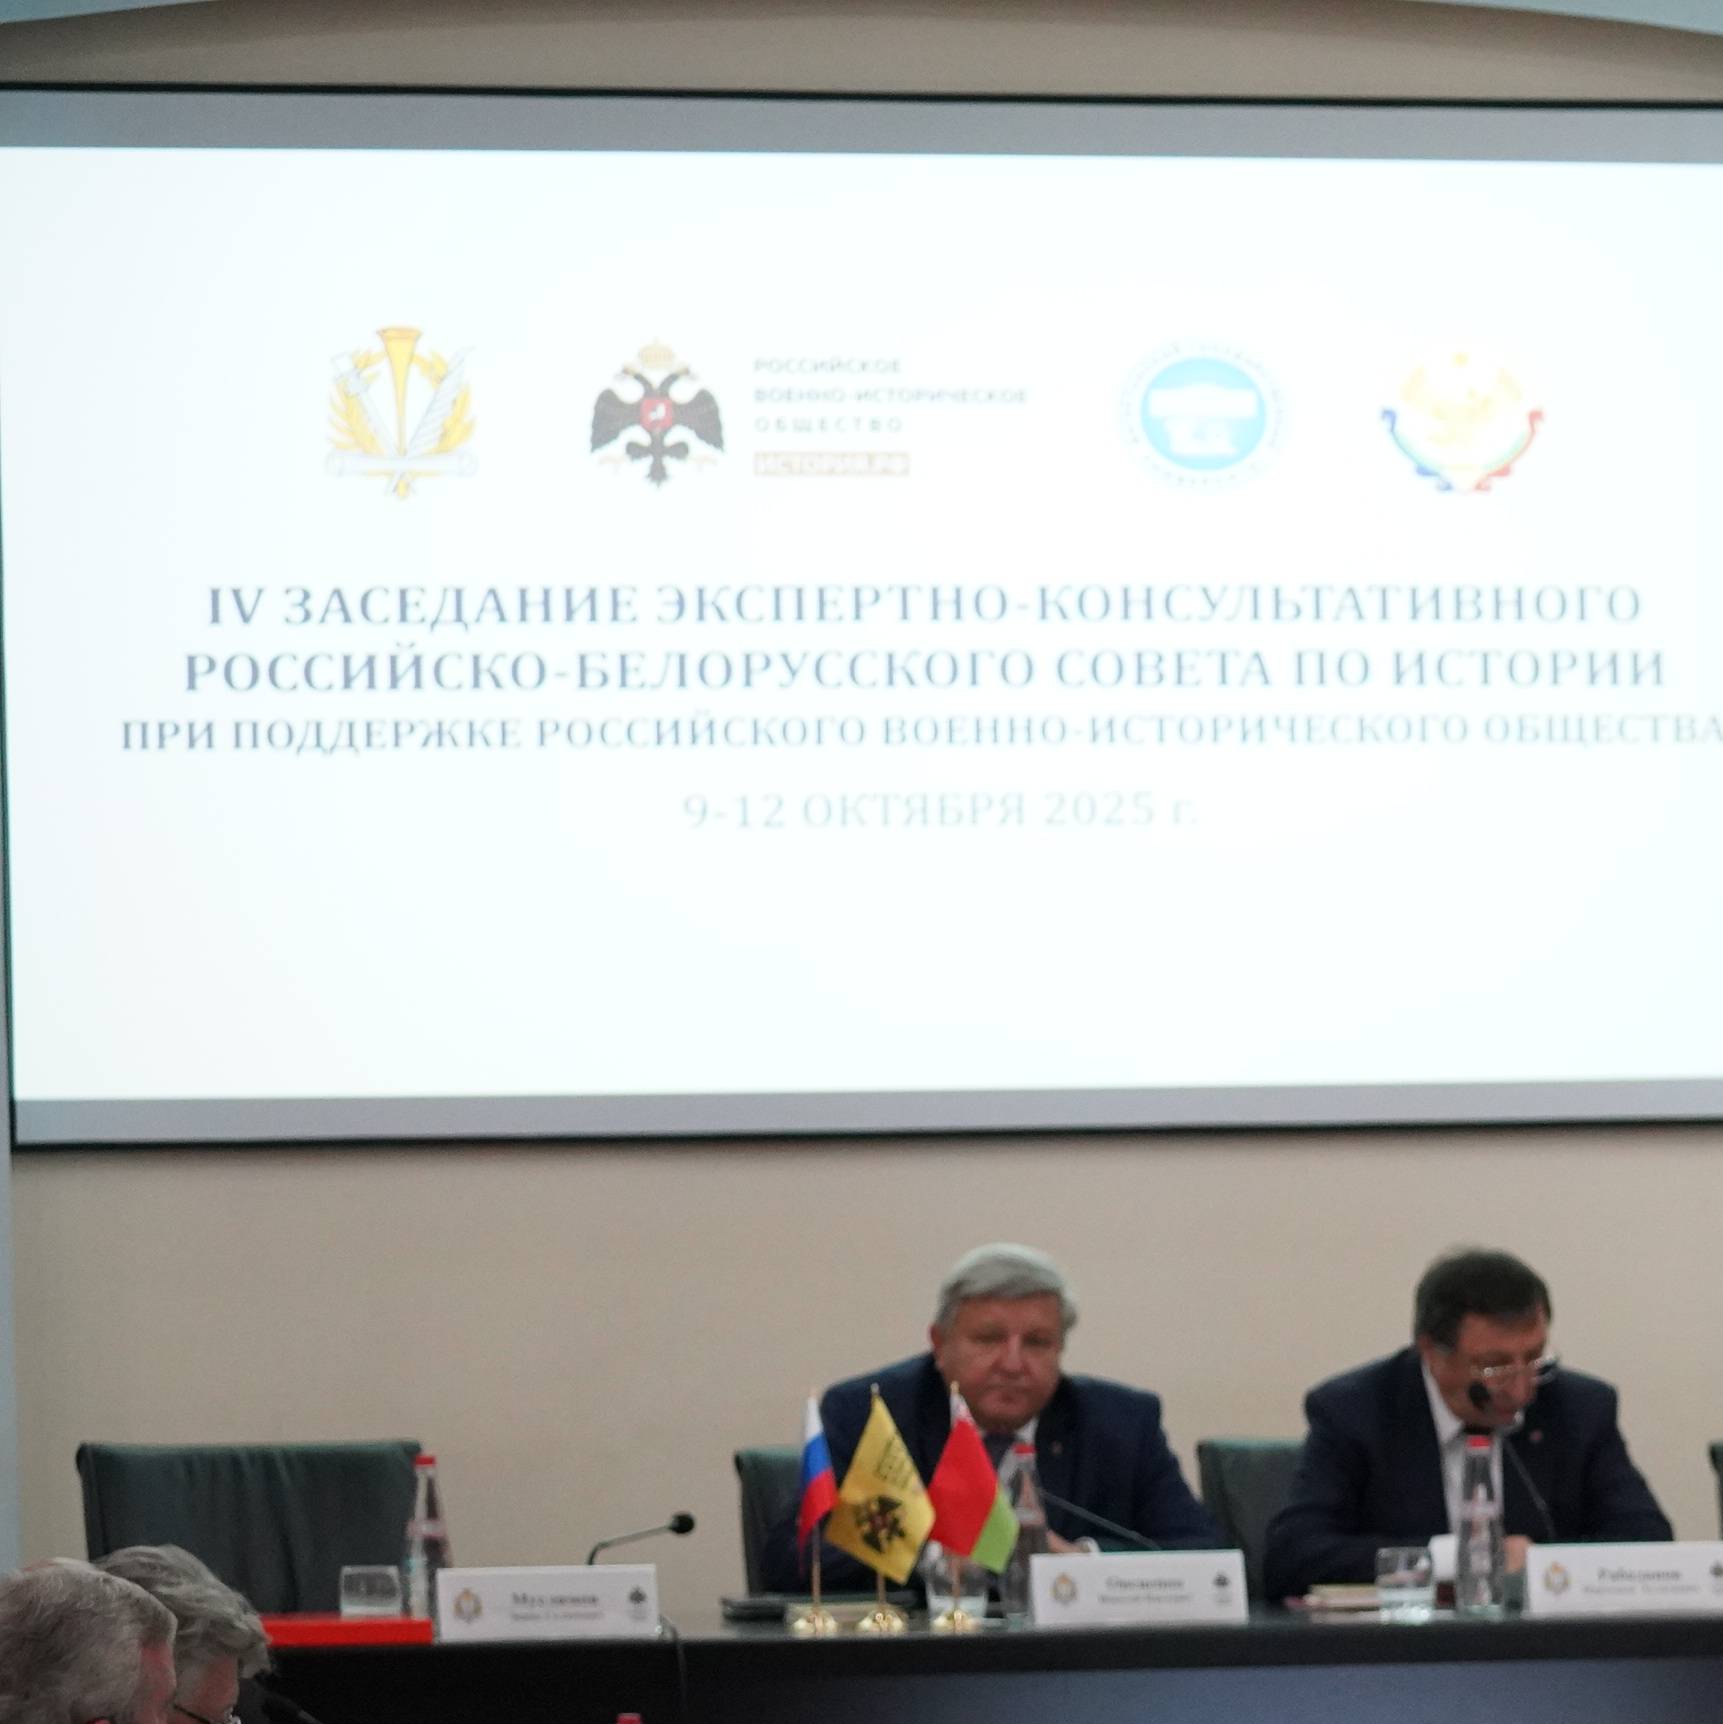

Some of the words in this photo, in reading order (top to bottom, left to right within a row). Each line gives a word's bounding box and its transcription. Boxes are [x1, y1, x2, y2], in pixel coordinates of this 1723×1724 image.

[753, 357, 902, 375] РОССИЙСКОЕ
[753, 387, 1028, 404] ВОЕННО-ИСТОРИЧЕСКОЕ
[754, 416, 903, 434] ОБЩЕСТВО
[208, 587, 263, 626] IV
[283, 586, 637, 632] ЗАСЕДАНИЕ
[656, 584, 1642, 625] ЭКСПЕРТНО-КОНСУЛЬТАТИВНОГО
[184, 642, 1034, 693] РОССИЙСКО-БЕЛОРУССКОГО
[1056, 649, 1272, 688] СОВЕТА
[1293, 650, 1371, 688] ПО
[1392, 649, 1664, 688] ИСТОРИИ
[121, 721, 215, 751] ПРИ
[233, 719, 521, 756] ПОДДЕРЖКЕ
[537, 709, 866, 748] РОССИЙСКОГО
[883, 714, 1469, 747] ВОЕННО-ИСТОРИЧЕСКОГО
[683, 793, 786, 830] 9-12
[802, 791, 1027, 829] ОКТЯБРЯ
[1044, 791, 1156, 829] 2025
